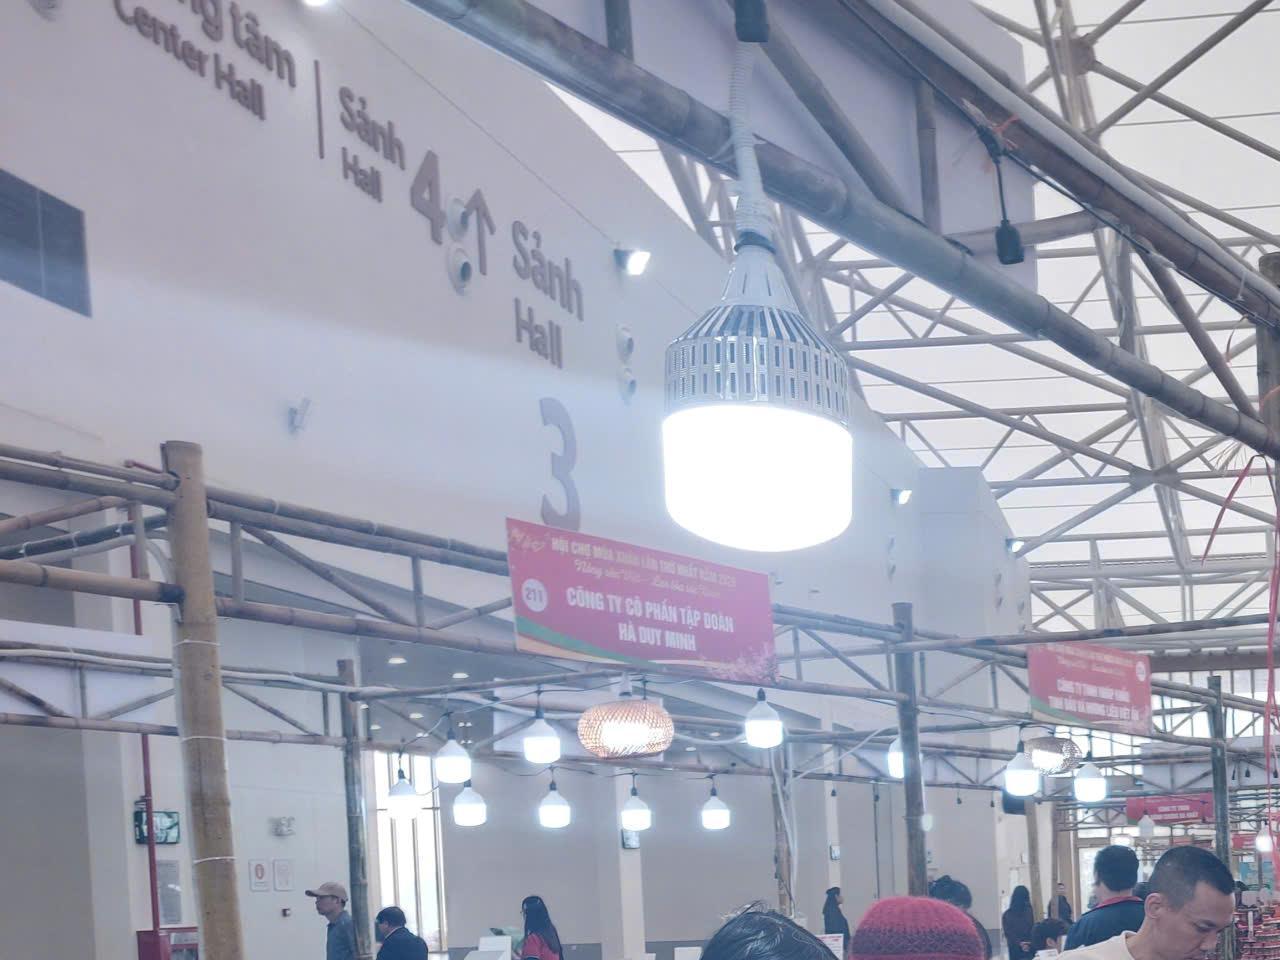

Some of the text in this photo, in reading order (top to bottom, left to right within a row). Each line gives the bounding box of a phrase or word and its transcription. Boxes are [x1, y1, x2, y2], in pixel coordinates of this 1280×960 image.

[214, 53, 266, 121] Hall
[338, 86, 406, 170] Sảnh
[341, 148, 383, 203] Hall
[410, 150, 445, 245] 4
[511, 220, 585, 321] Sảnh
[514, 298, 563, 369] Hall
[539, 397, 581, 531] 3
[566, 586, 604, 611] CÔNG
[606, 594, 622, 614] TY
[646, 599, 677, 624] PHẦN
[679, 607, 701, 630] TẬP
[618, 621, 697, 652] HÀ DUY MINH
